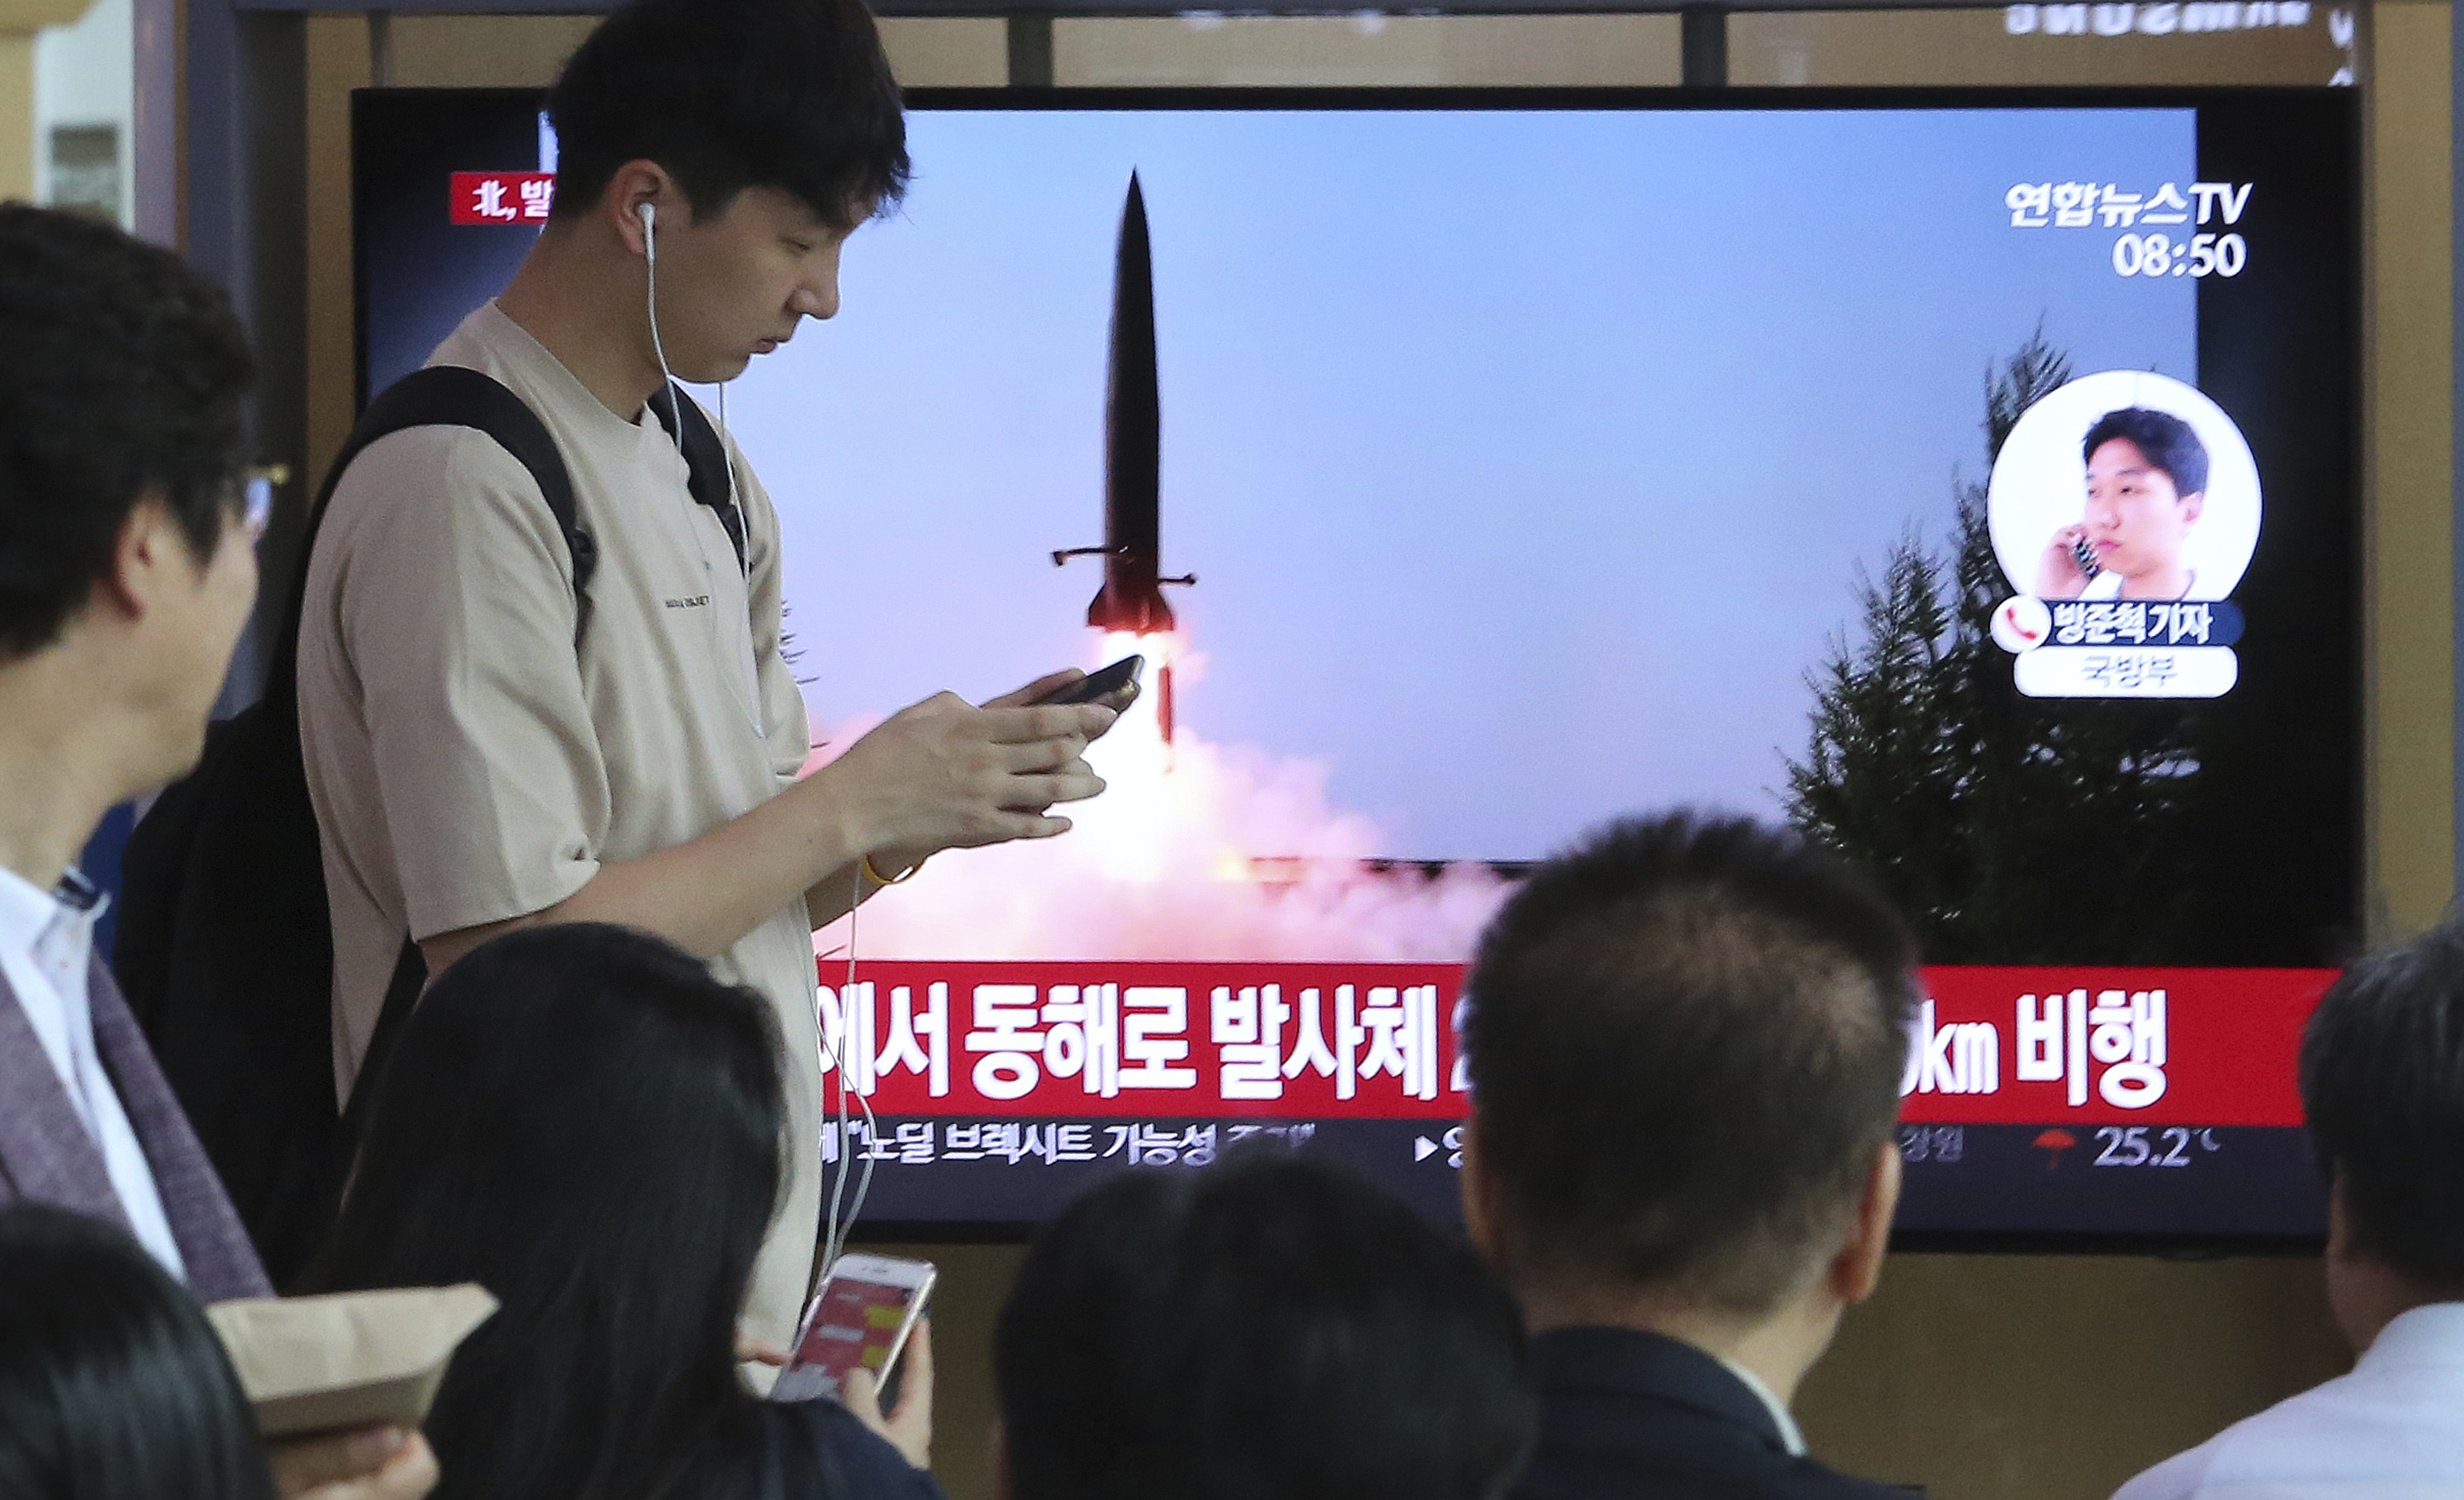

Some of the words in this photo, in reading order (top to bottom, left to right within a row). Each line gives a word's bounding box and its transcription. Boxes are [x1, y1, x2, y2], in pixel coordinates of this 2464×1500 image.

[2004, 182, 2253, 228] 연합뉴스TV
[2111, 232, 2247, 277] 08:50
[2148, 602, 2213, 644] 기자
[2081, 654, 2178, 689] 국방부
[965, 983, 1198, 1100] 동해로
[1210, 983, 1438, 1100] 발사체
[2016, 988, 2167, 1109] 비행
[941, 1121, 1097, 1166] 브렉시트
[1102, 1121, 1217, 1167] 가능성
